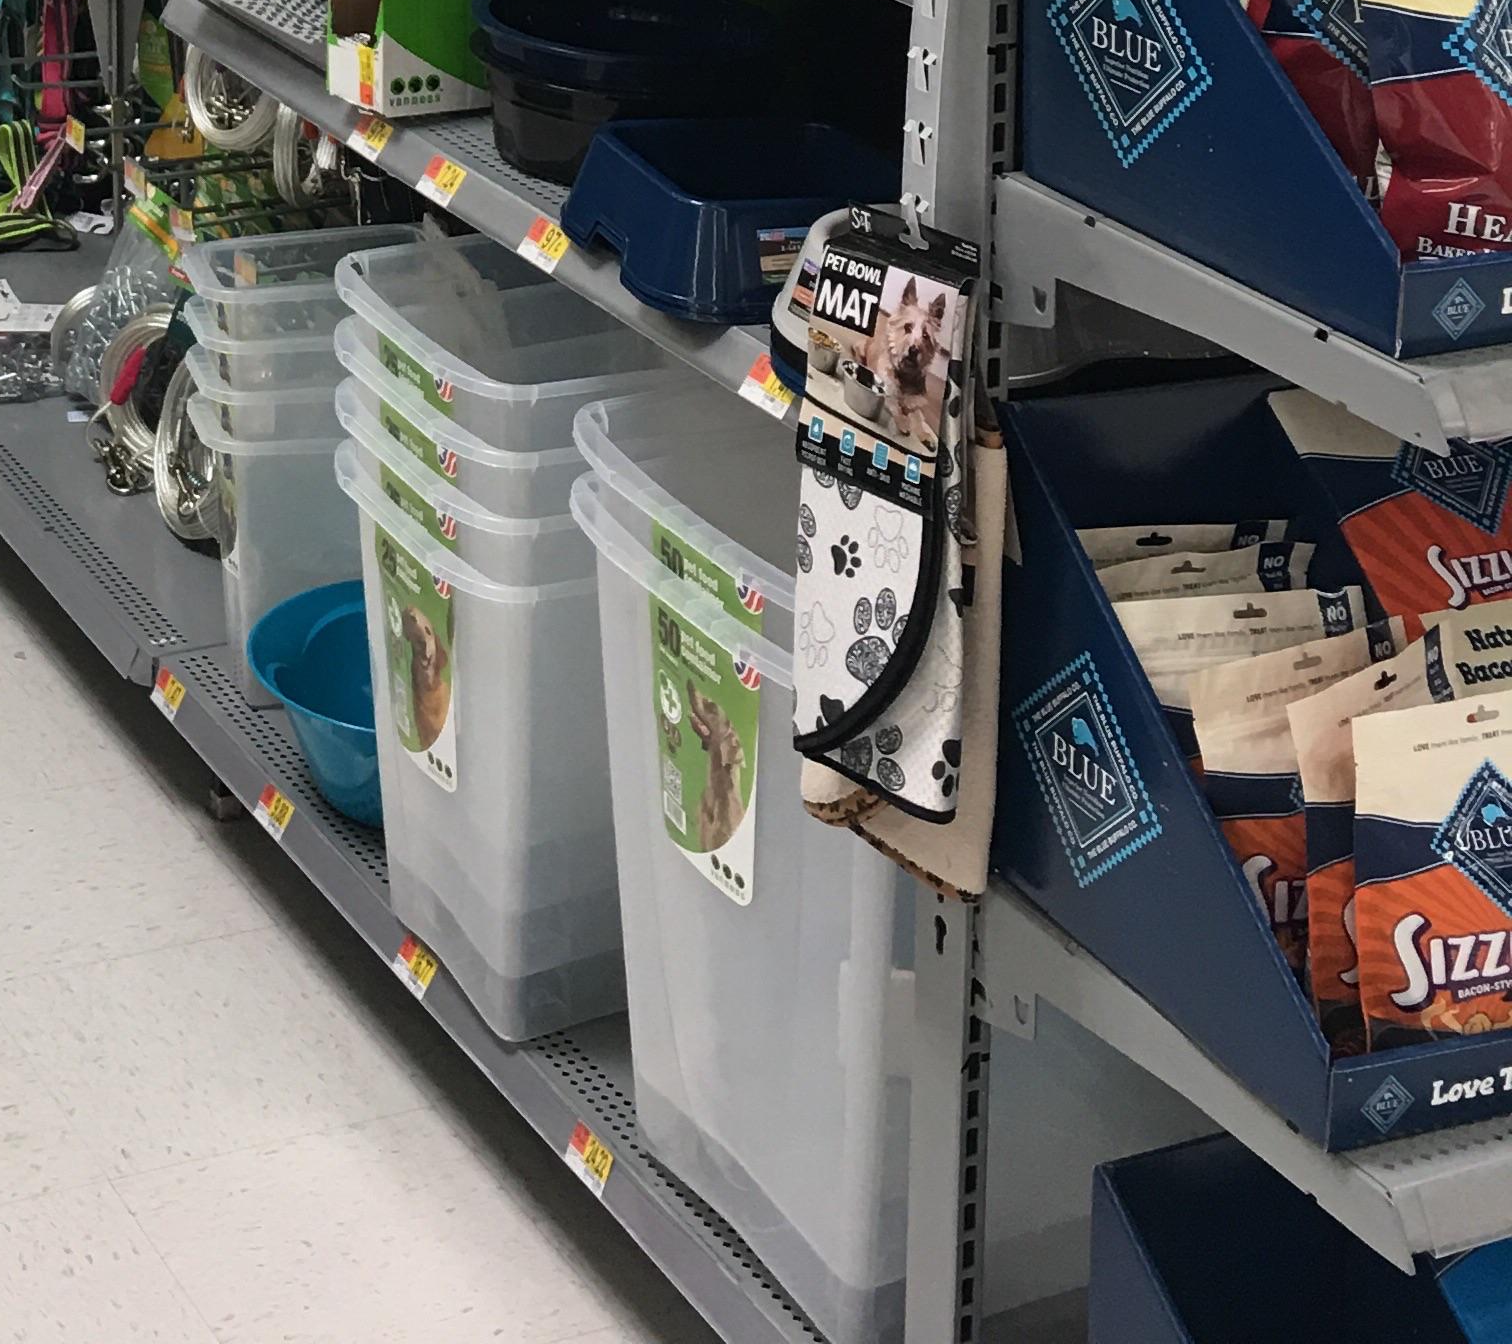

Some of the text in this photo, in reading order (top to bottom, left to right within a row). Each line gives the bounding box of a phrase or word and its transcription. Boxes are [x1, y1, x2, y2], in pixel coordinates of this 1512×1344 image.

[1091, 16, 1163, 73] BLUE
[1155, 6, 1179, 46] BUFFALO
[824, 252, 882, 286] PET BOWL
[816, 278, 878, 330] MAT
[1424, 454, 1484, 479] BLUE
[1263, 555, 1285, 569] NO
[658, 606, 681, 658] 50
[1374, 640, 1391, 658] NO
[1099, 712, 1113, 740] BLUE
[1052, 731, 1118, 806] BLUE
[1390, 913, 1512, 1008] SIZZ
[1431, 1079, 1495, 1106] Love
